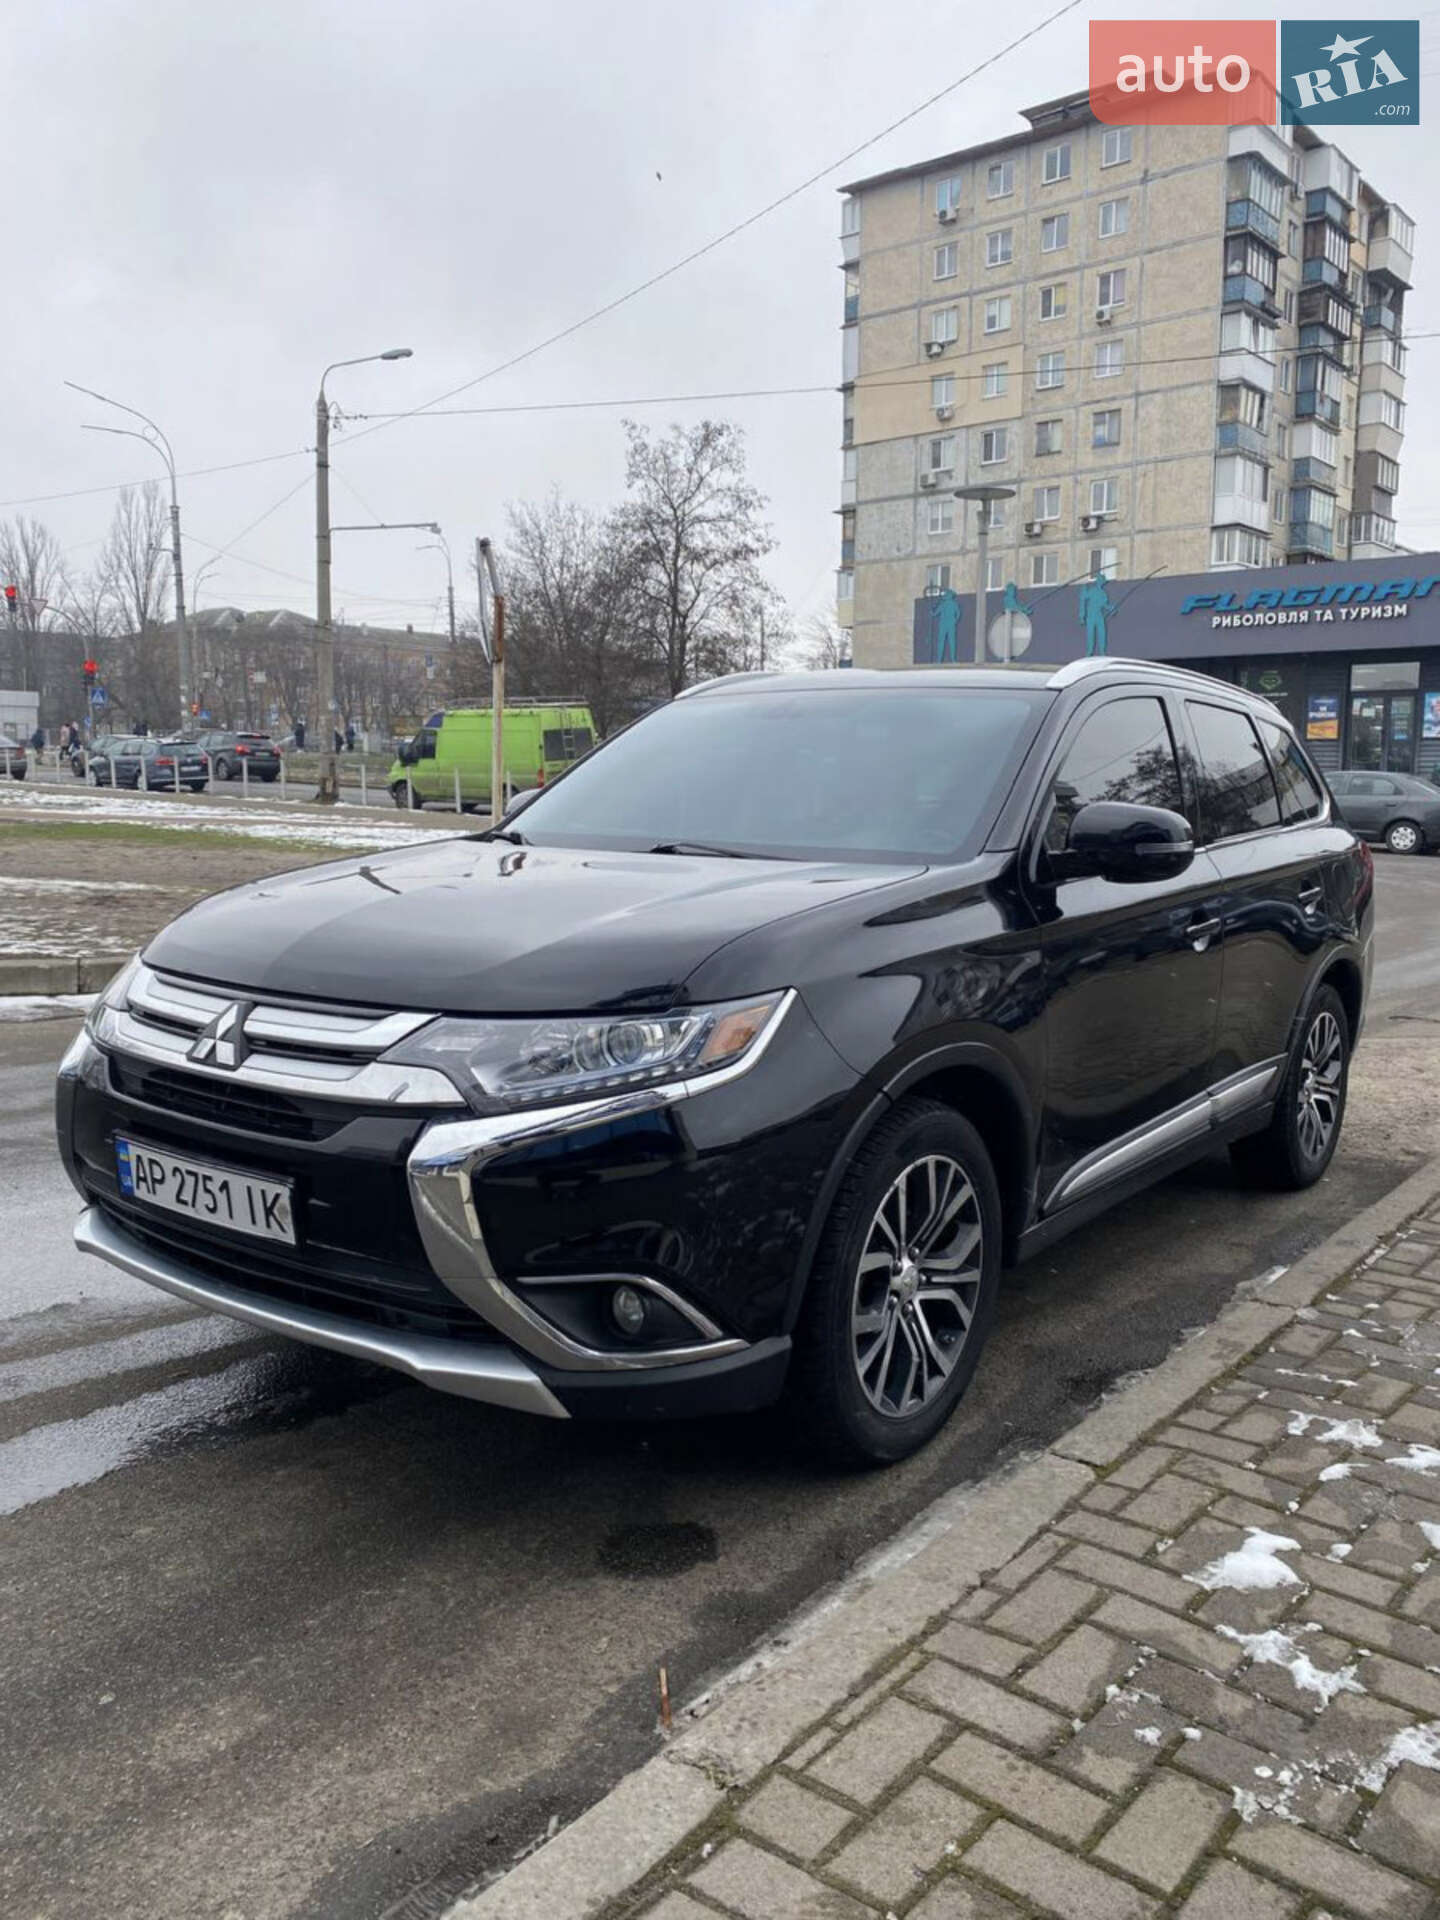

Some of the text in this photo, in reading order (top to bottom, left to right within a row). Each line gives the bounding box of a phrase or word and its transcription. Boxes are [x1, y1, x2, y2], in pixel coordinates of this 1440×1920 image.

[1211, 603, 1408, 629] РИБОЛОВЛЯ ТА ТУРИЗМ
[135, 1154, 288, 1234] AP 2751 IK
